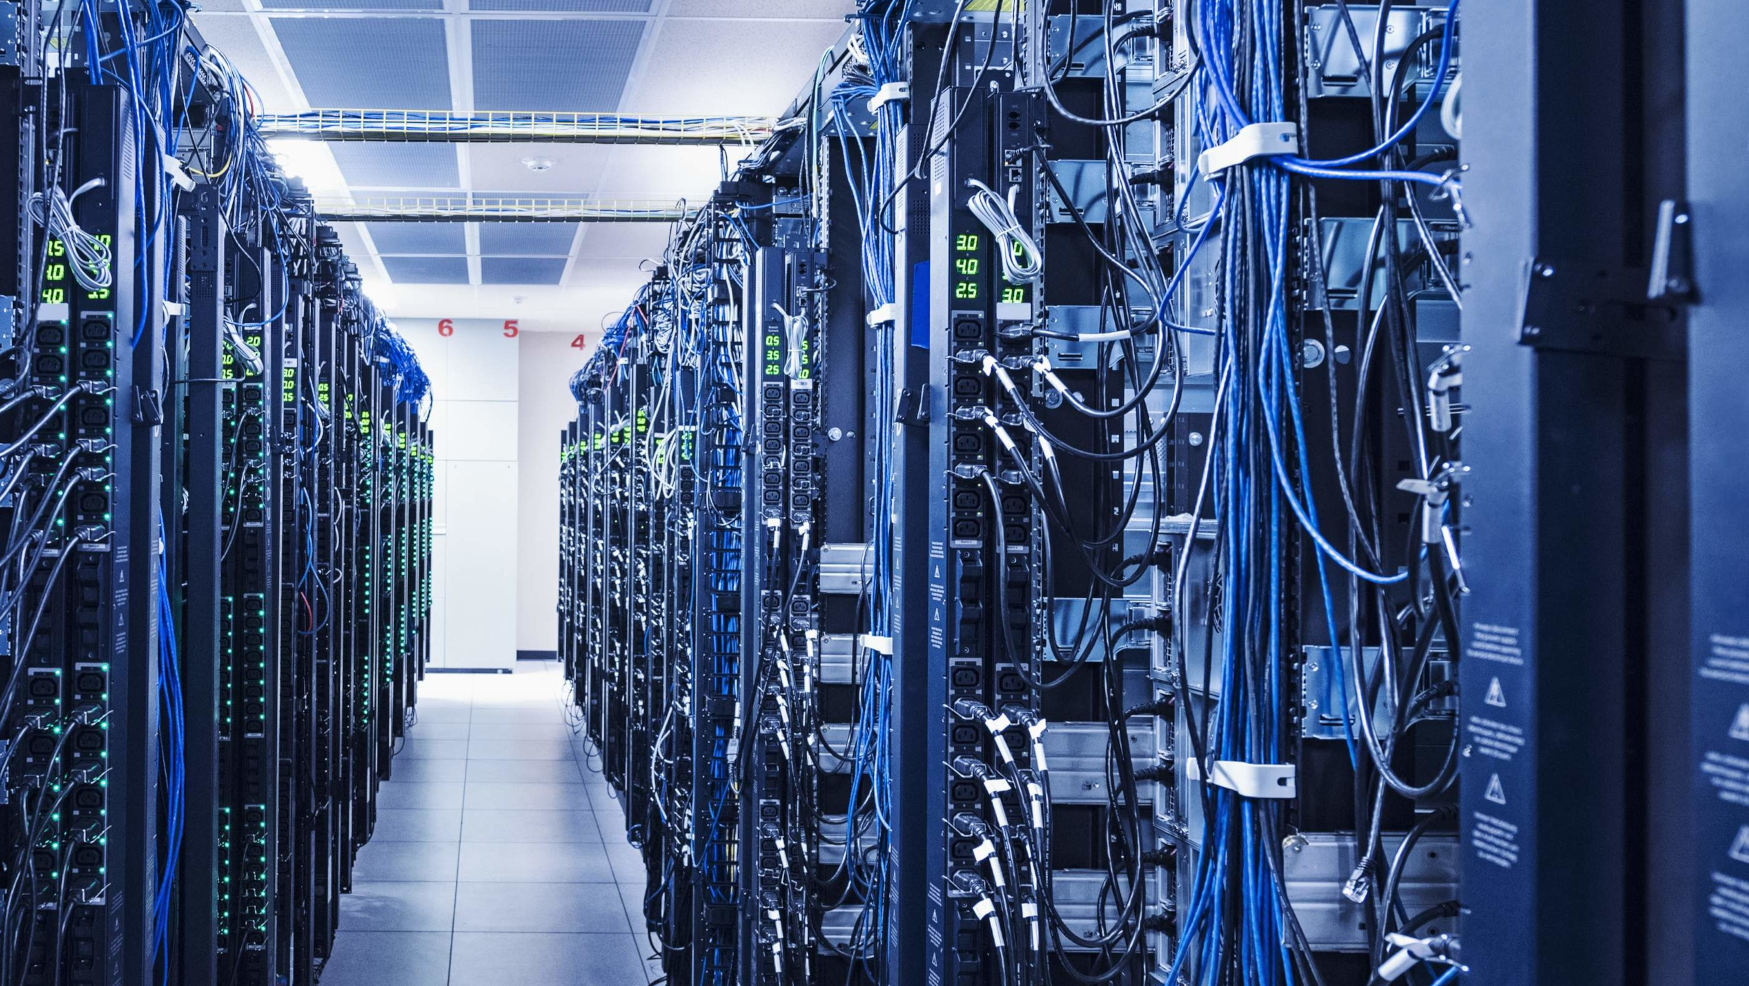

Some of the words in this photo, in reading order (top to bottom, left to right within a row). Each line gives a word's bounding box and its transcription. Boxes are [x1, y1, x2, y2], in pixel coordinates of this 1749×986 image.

[437, 318, 454, 338] 6
[503, 319, 519, 338] 5
[570, 333, 585, 351] 4
